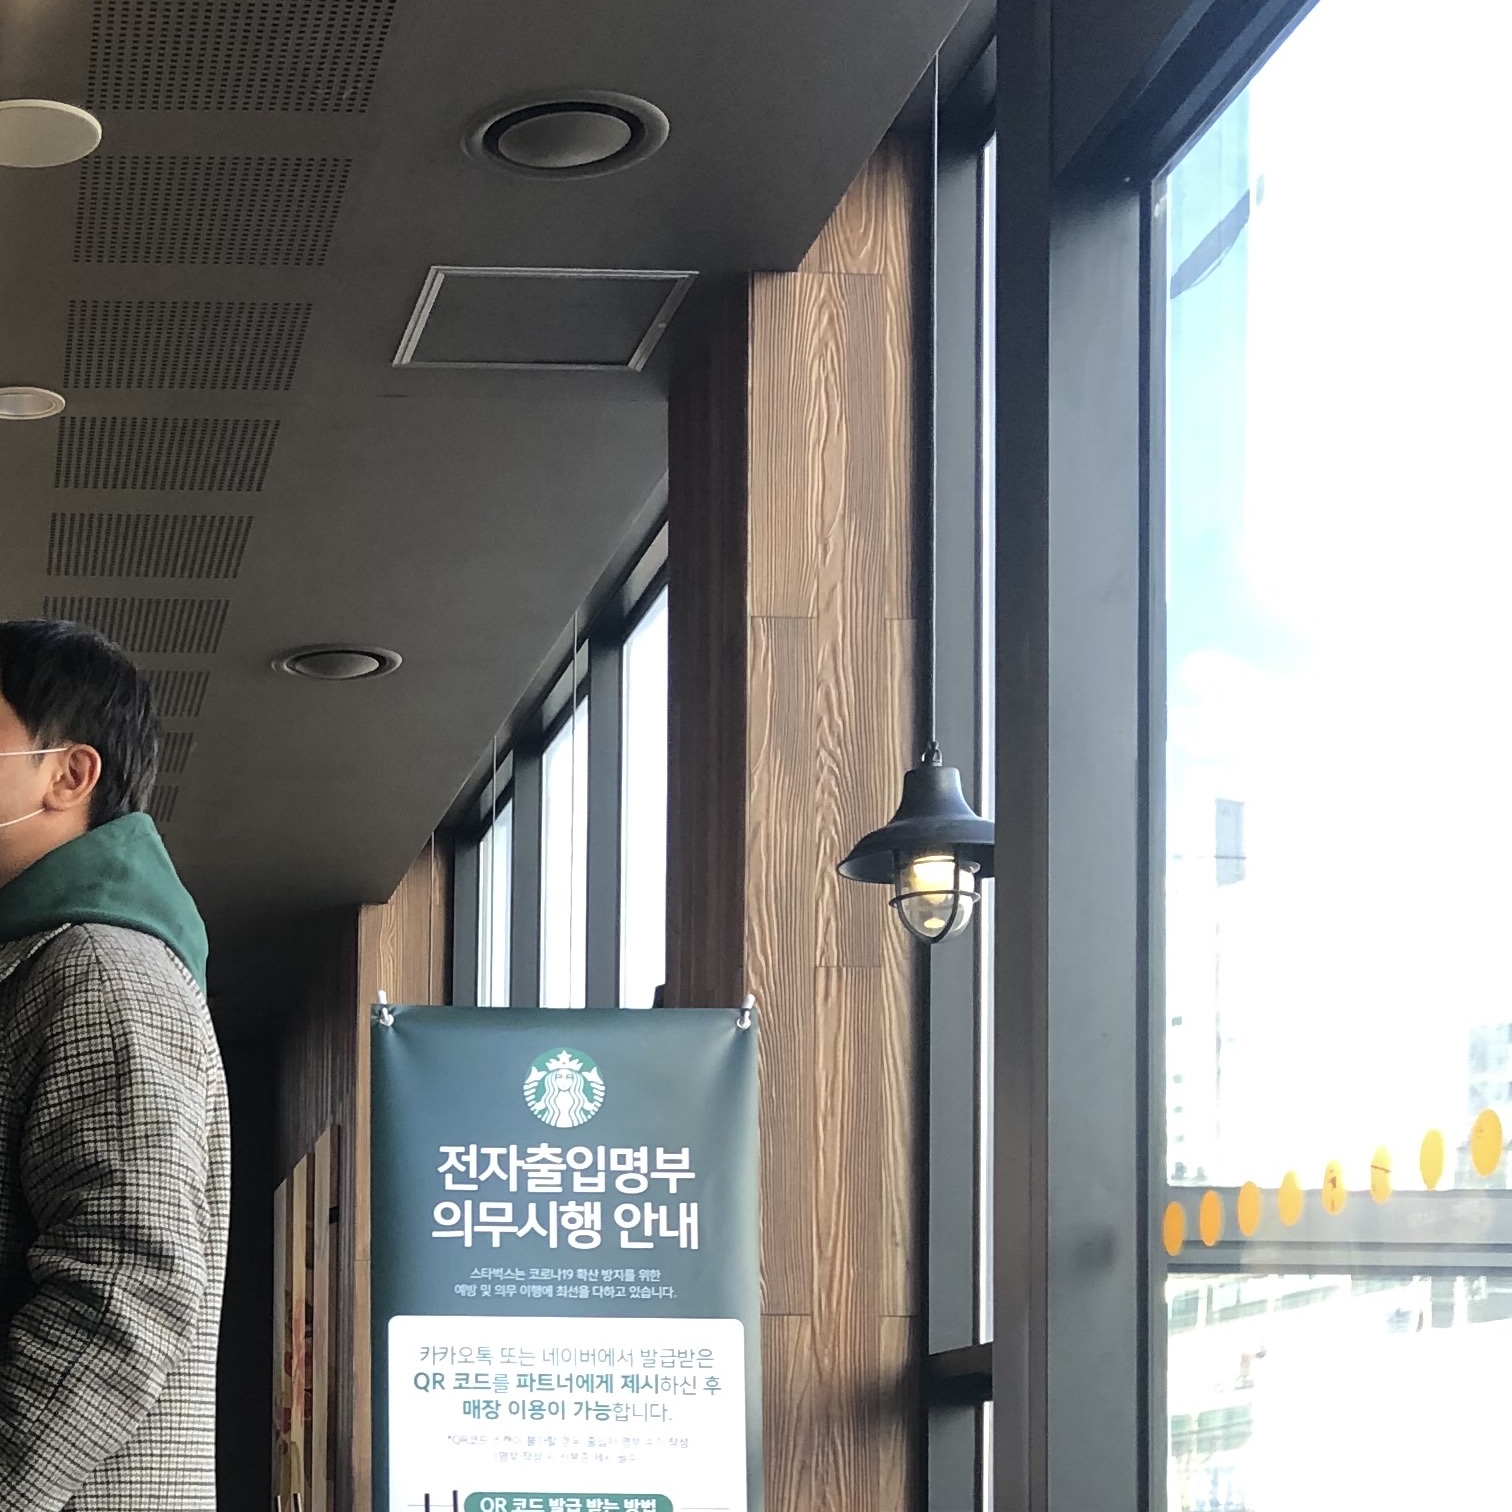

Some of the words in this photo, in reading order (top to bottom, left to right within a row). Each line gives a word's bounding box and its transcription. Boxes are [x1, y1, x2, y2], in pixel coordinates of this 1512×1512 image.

[437, 1143, 696, 1194] 전자출입명부
[431, 1200, 601, 1250] 의무시행
[614, 1202, 699, 1250] 안내
[470, 1267, 526, 1281] 스타벅스는
[528, 1268, 573, 1281] 코로나19
[576, 1268, 599, 1282] 확산
[601, 1269, 635, 1282] 방지를
[639, 1269, 662, 1282] 위한
[454, 1283, 477, 1297] 예방
[480, 1284, 491, 1297] 및
[495, 1284, 517, 1298] 의무
[519, 1284, 553, 1298] 이행에
[556, 1285, 590, 1298] 최선을
[592, 1286, 626, 1299] 다하고
[629, 1286, 678, 1300] 있습니다.
[419, 1346, 493, 1366] 카카오톡
[500, 1347, 535, 1366] 또는
[542, 1347, 633, 1368] 네이버에서
[640, 1348, 714, 1369] 발급받은
[413, 1372, 445, 1392] QR
[453, 1372, 510, 1394] 코드를
[516, 1373, 613, 1394] 파트너에게
[621, 1374, 697, 1396] 제시하신
[703, 1375, 722, 1396] 후
[462, 1399, 501, 1420] 매장
[508, 1399, 565, 1421] 이용이
[573, 1400, 672, 1422] 가능합니다.
